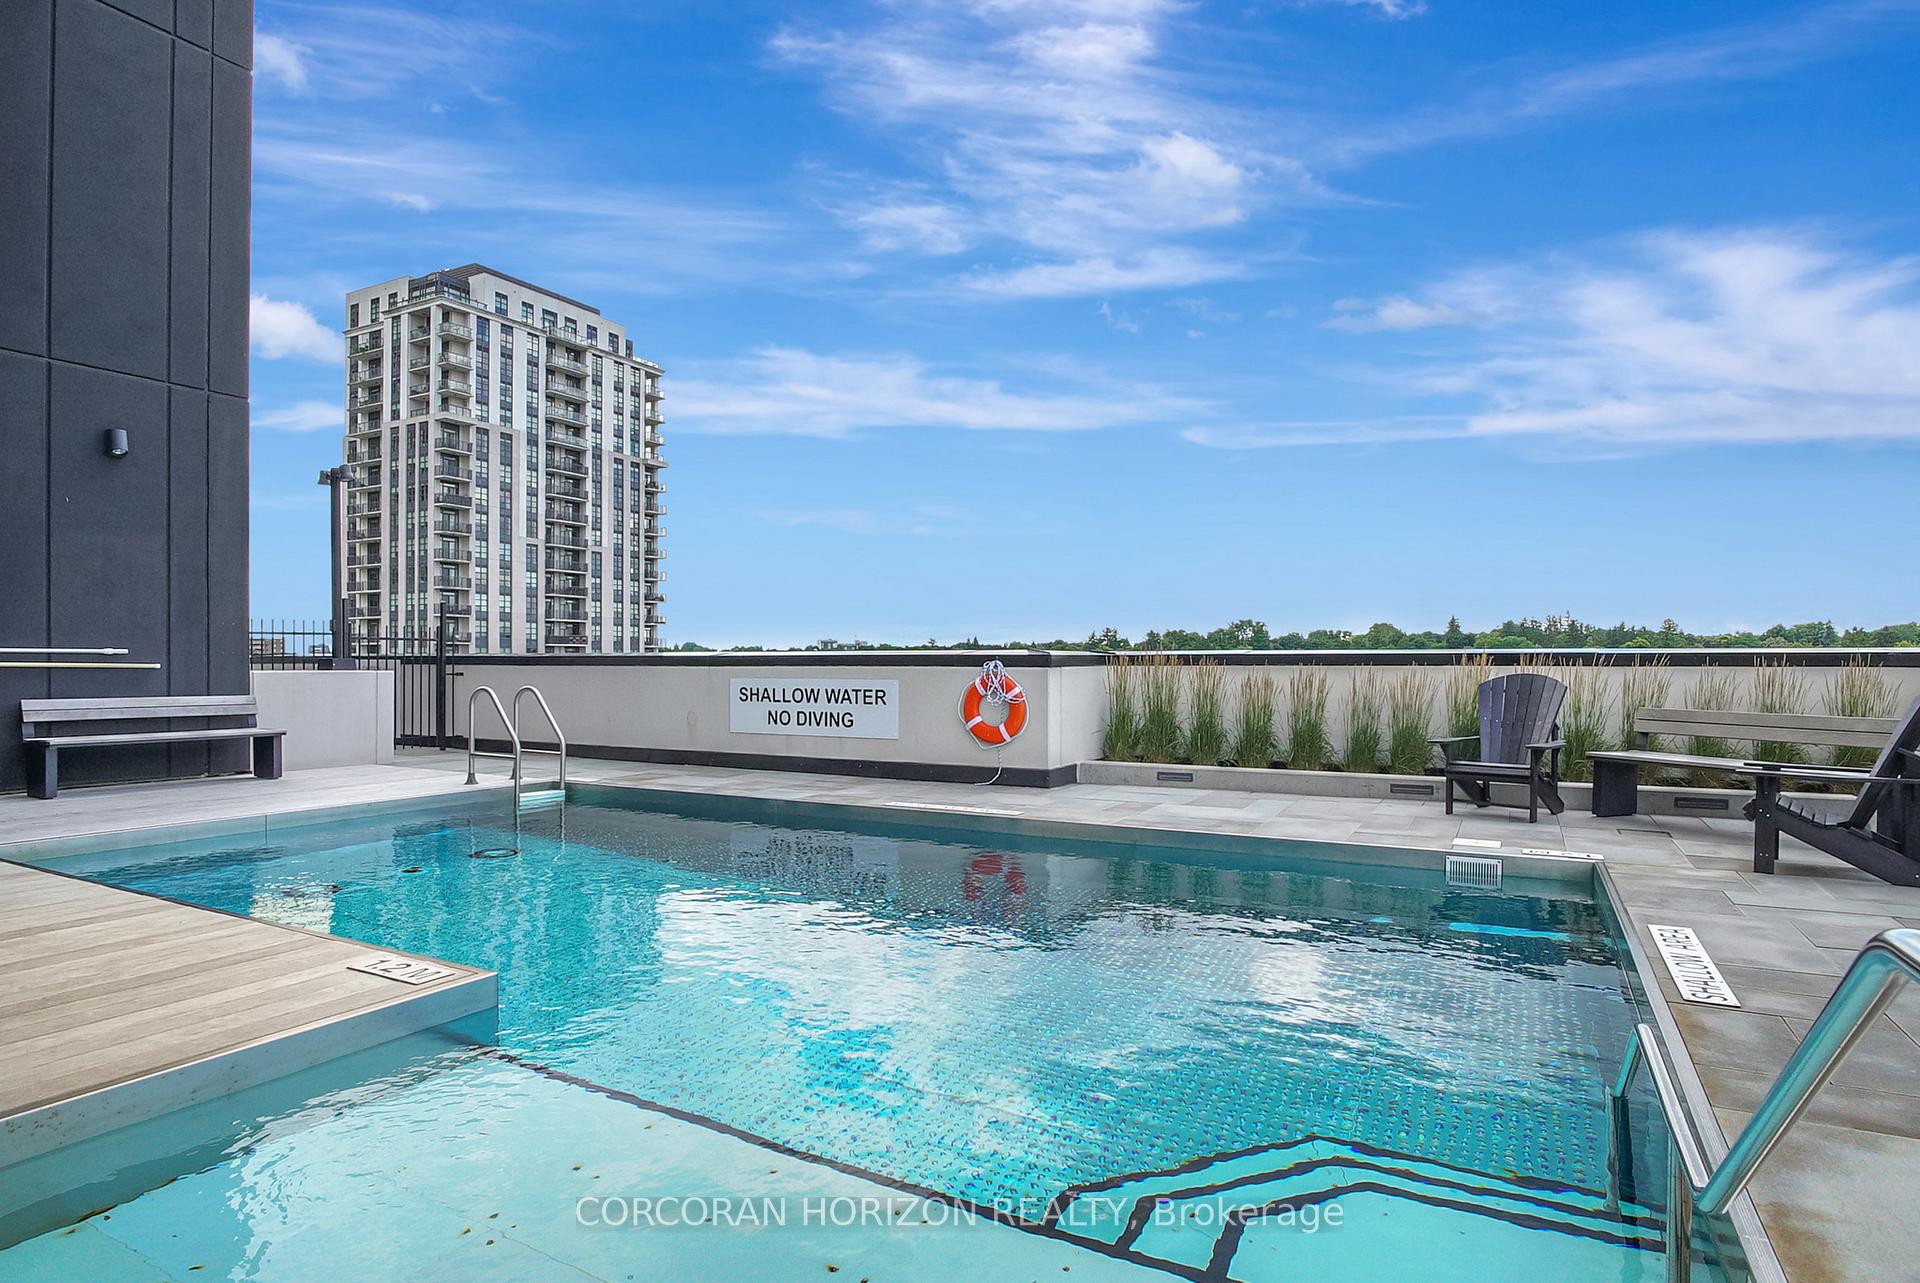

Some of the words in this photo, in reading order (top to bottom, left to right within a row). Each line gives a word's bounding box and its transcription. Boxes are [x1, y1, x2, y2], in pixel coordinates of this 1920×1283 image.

[739, 687, 820, 703] SHALLOW
[825, 688, 887, 705] WATER
[767, 710, 791, 726] NO
[796, 711, 854, 728] DIVING
[1657, 928, 1697, 951] AREA
[1668, 952, 1728, 1001] SHALLOW
